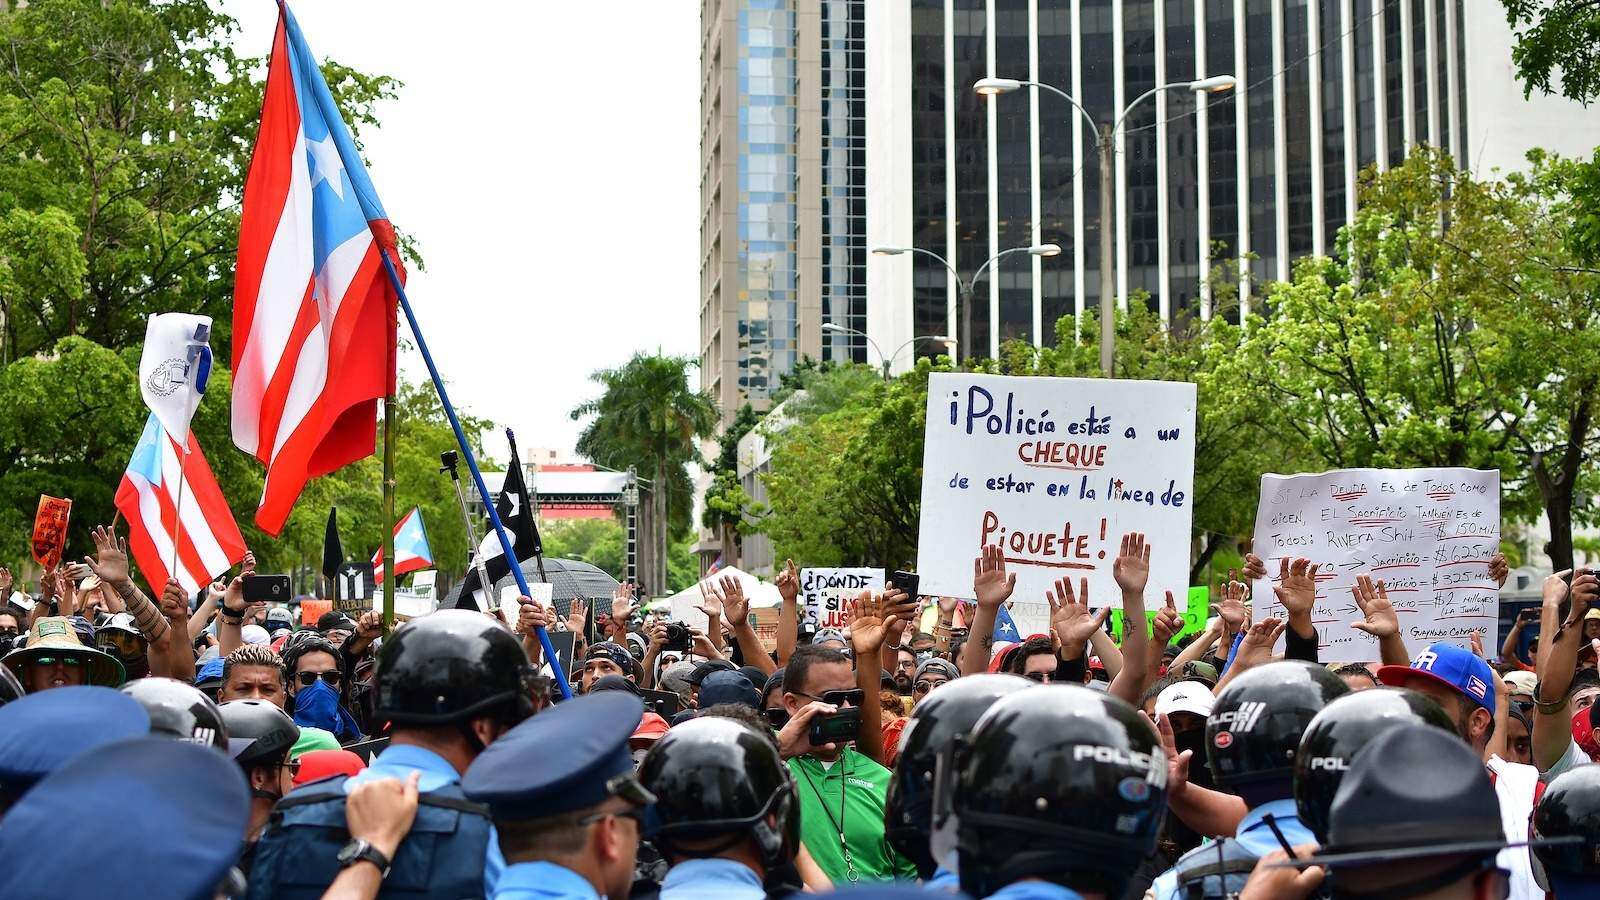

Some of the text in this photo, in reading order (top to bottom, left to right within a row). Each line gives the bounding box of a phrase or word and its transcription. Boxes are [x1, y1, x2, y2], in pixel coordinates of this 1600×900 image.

[1068, 406, 1111, 436] estás
[1124, 427, 1136, 440] a
[1018, 441, 1107, 467] CHEQUE
[949, 472, 969, 490] de
[986, 473, 1035, 494] estar
[1079, 475, 1096, 501] la
[1160, 480, 1185, 507] de
[1423, 479, 1455, 493] Todos
[1321, 508, 1341, 521] EL
[1380, 527, 1415, 542] Shit
